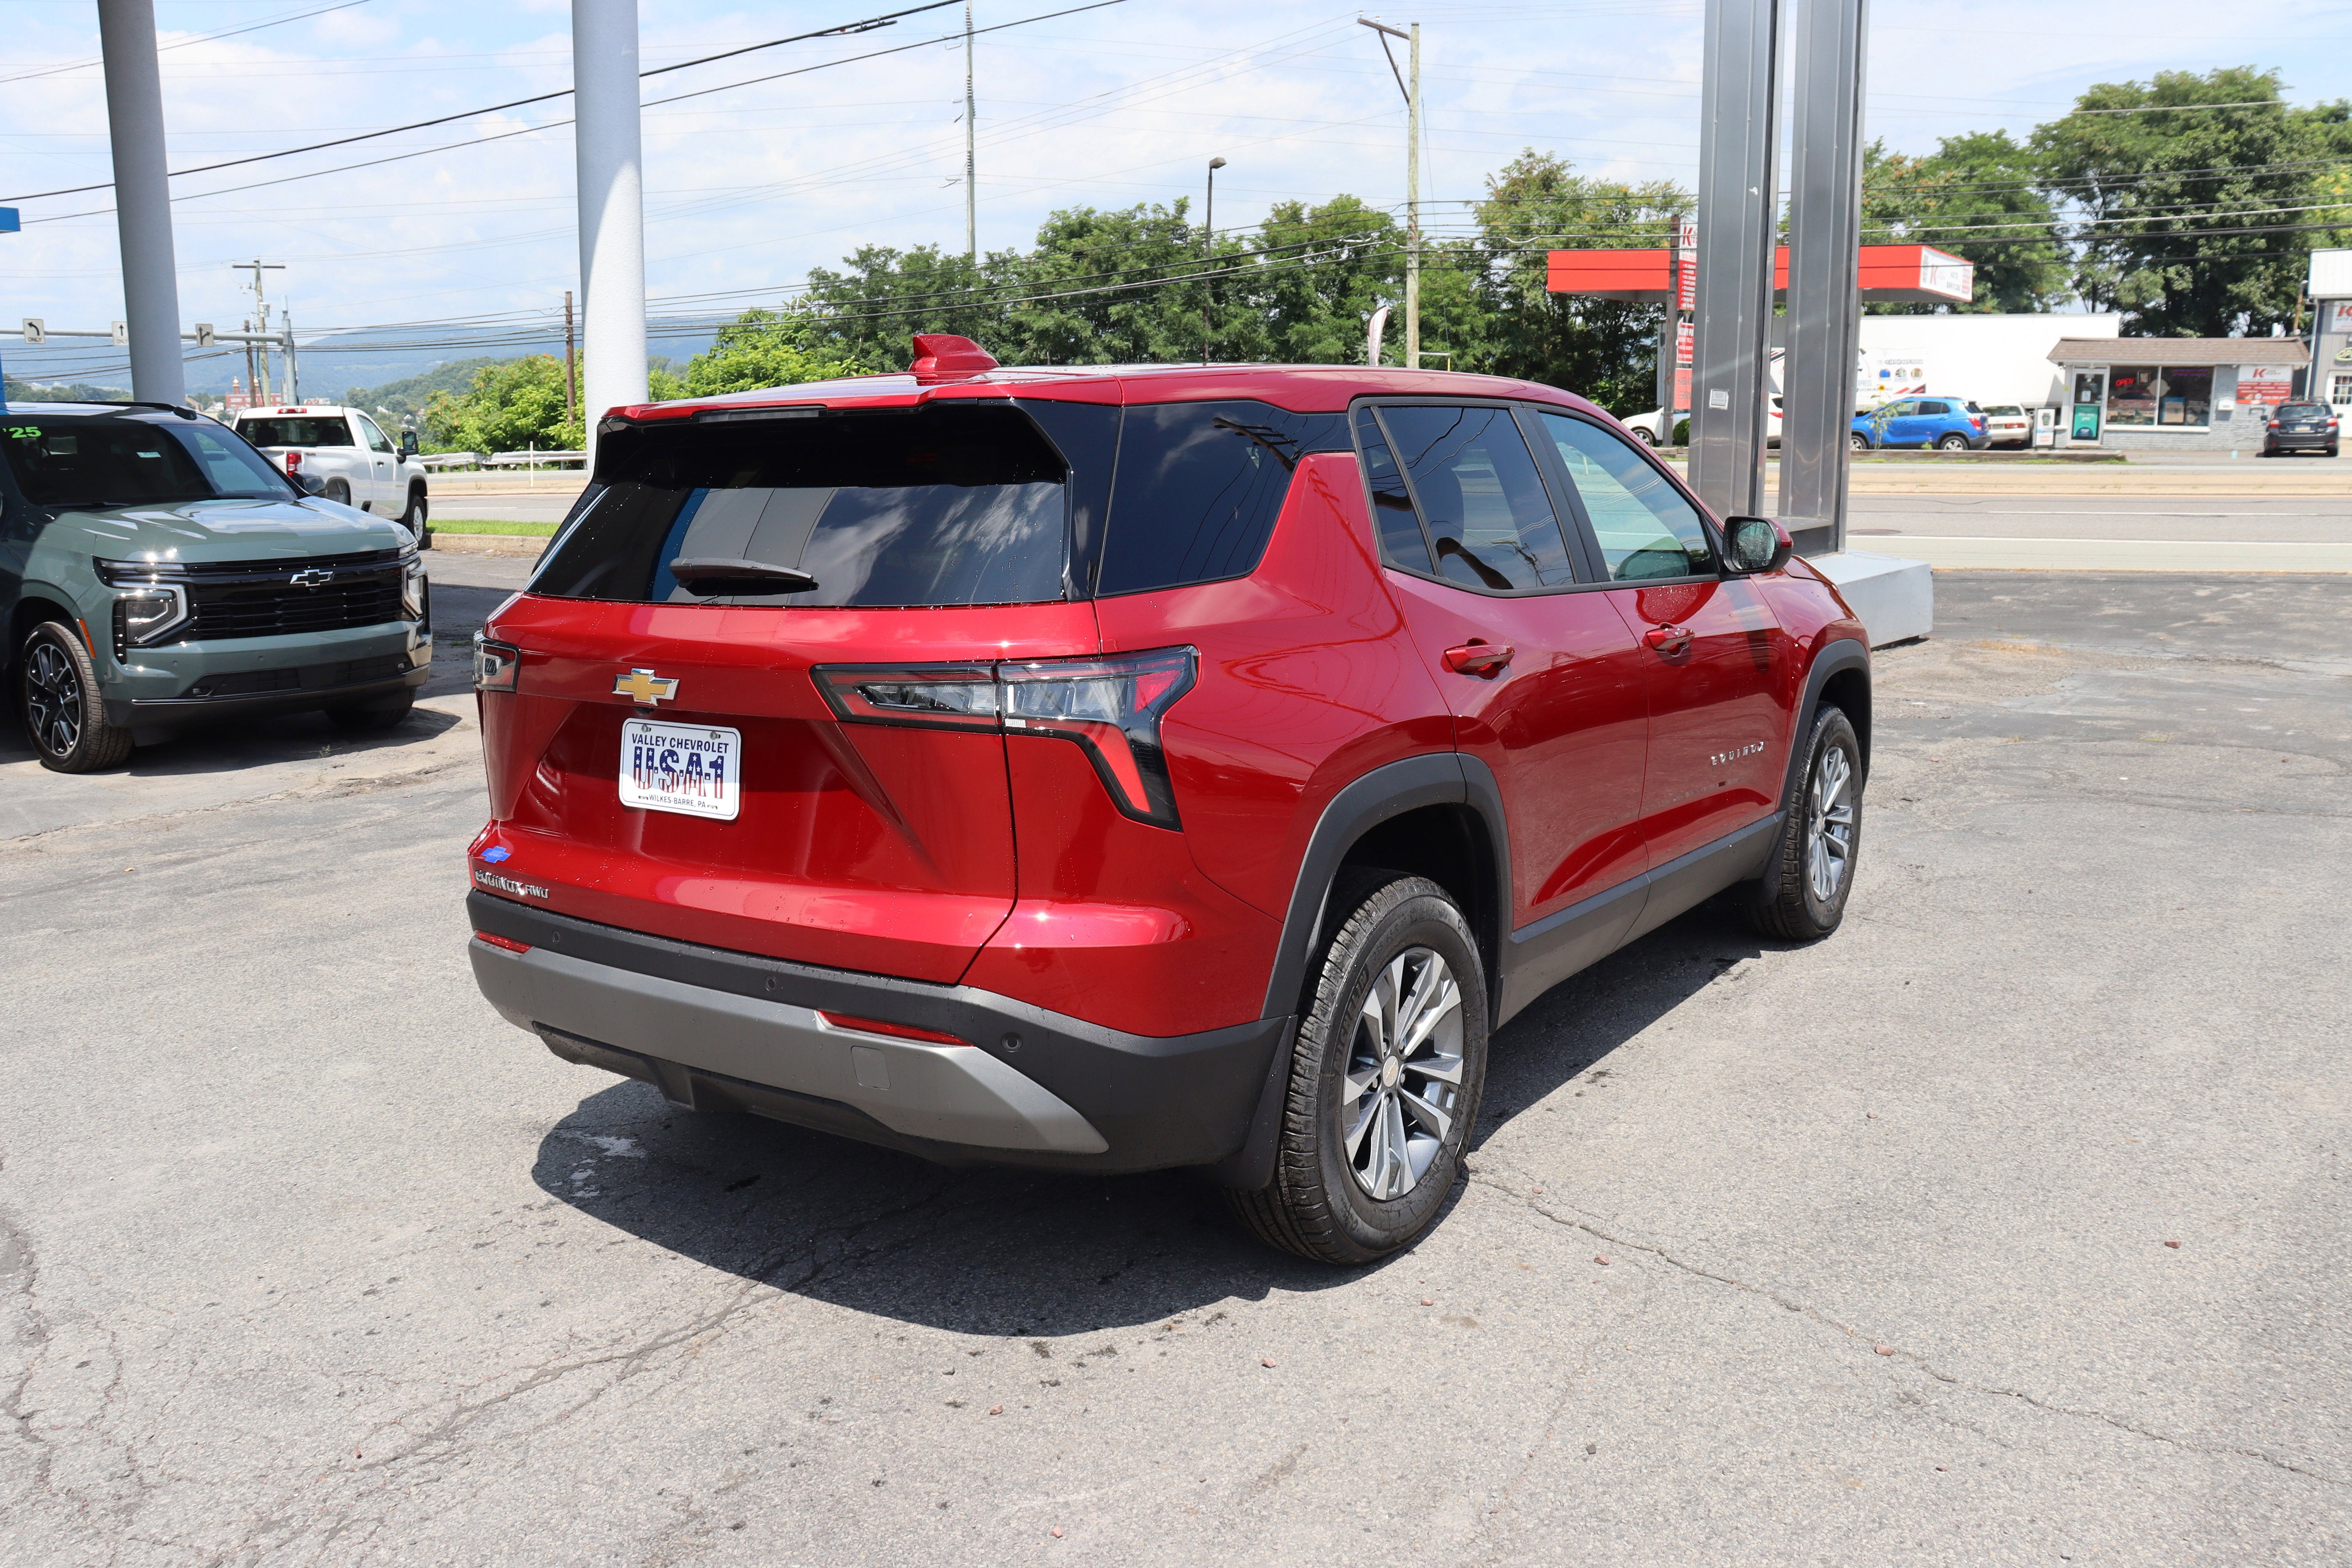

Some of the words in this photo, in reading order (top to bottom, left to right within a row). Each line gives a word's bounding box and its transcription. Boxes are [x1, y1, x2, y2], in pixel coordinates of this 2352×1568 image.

[2115, 378, 2134, 387] OPEN
[632, 733, 667, 747] VALLEY
[669, 737, 729, 754] CHEVROLET
[1711, 741, 1764, 766] EQUINOX
[649, 794, 696, 808] WILKES-BARRE,
[475, 870, 524, 895] EQUINOX
[525, 884, 550, 899] AWD
